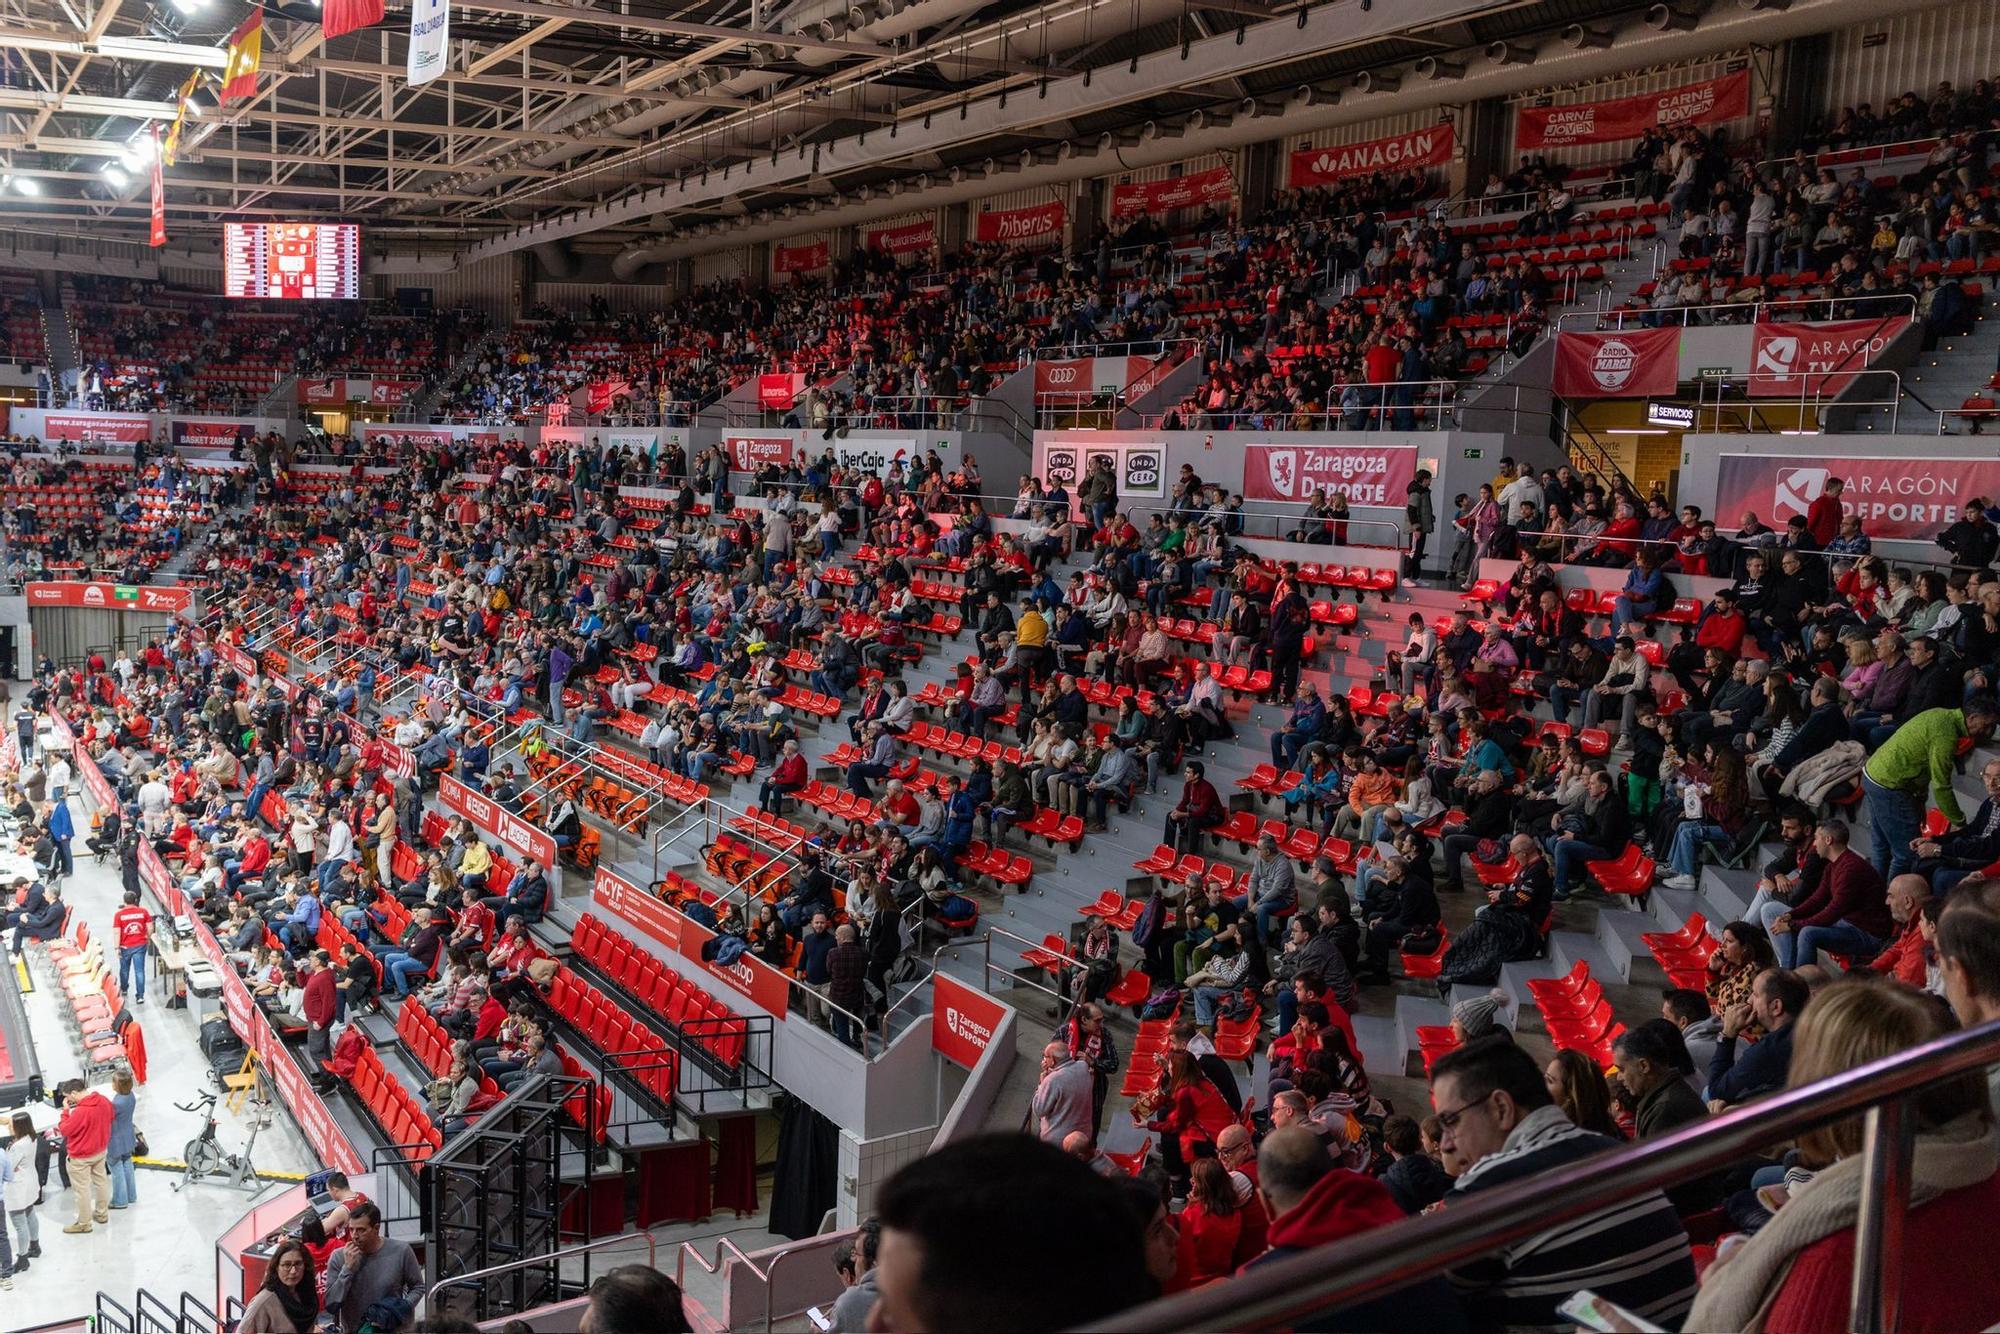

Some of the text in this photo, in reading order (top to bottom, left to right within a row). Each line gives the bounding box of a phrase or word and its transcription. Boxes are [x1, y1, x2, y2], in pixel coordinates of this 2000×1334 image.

[1658, 84, 1714, 109] CARNÉ
[1548, 108, 1595, 124] CARNÉ
[1657, 99, 1715, 123] JOVEN
[1545, 120, 1595, 136] JOVEN
[1338, 134, 1433, 171] ANAGAN
[997, 213, 1053, 238] hiberus
[1602, 348, 1628, 356] RADIO
[1809, 333, 1892, 356] ARAGÓ
[1595, 358, 1632, 370] MARCA
[1808, 361, 1835, 373] TV
[1658, 406, 1694, 419] SERVICIOS
[180, 435, 208, 445] BASKET
[749, 440, 782, 458] Zaragoza
[840, 449, 885, 472] iberCaja
[1051, 457, 1072, 465] ONDA
[1131, 459, 1154, 467] ONDA
[1303, 451, 1388, 478] Zaragoza
[1842, 472, 1958, 496] ARAGÓN
[1843, 502, 1956, 523] DEPORTE
[597, 875, 624, 902] ACYF
[959, 1013, 990, 1038] Zaragoza
[959, 1025, 988, 1049] DEPORT
